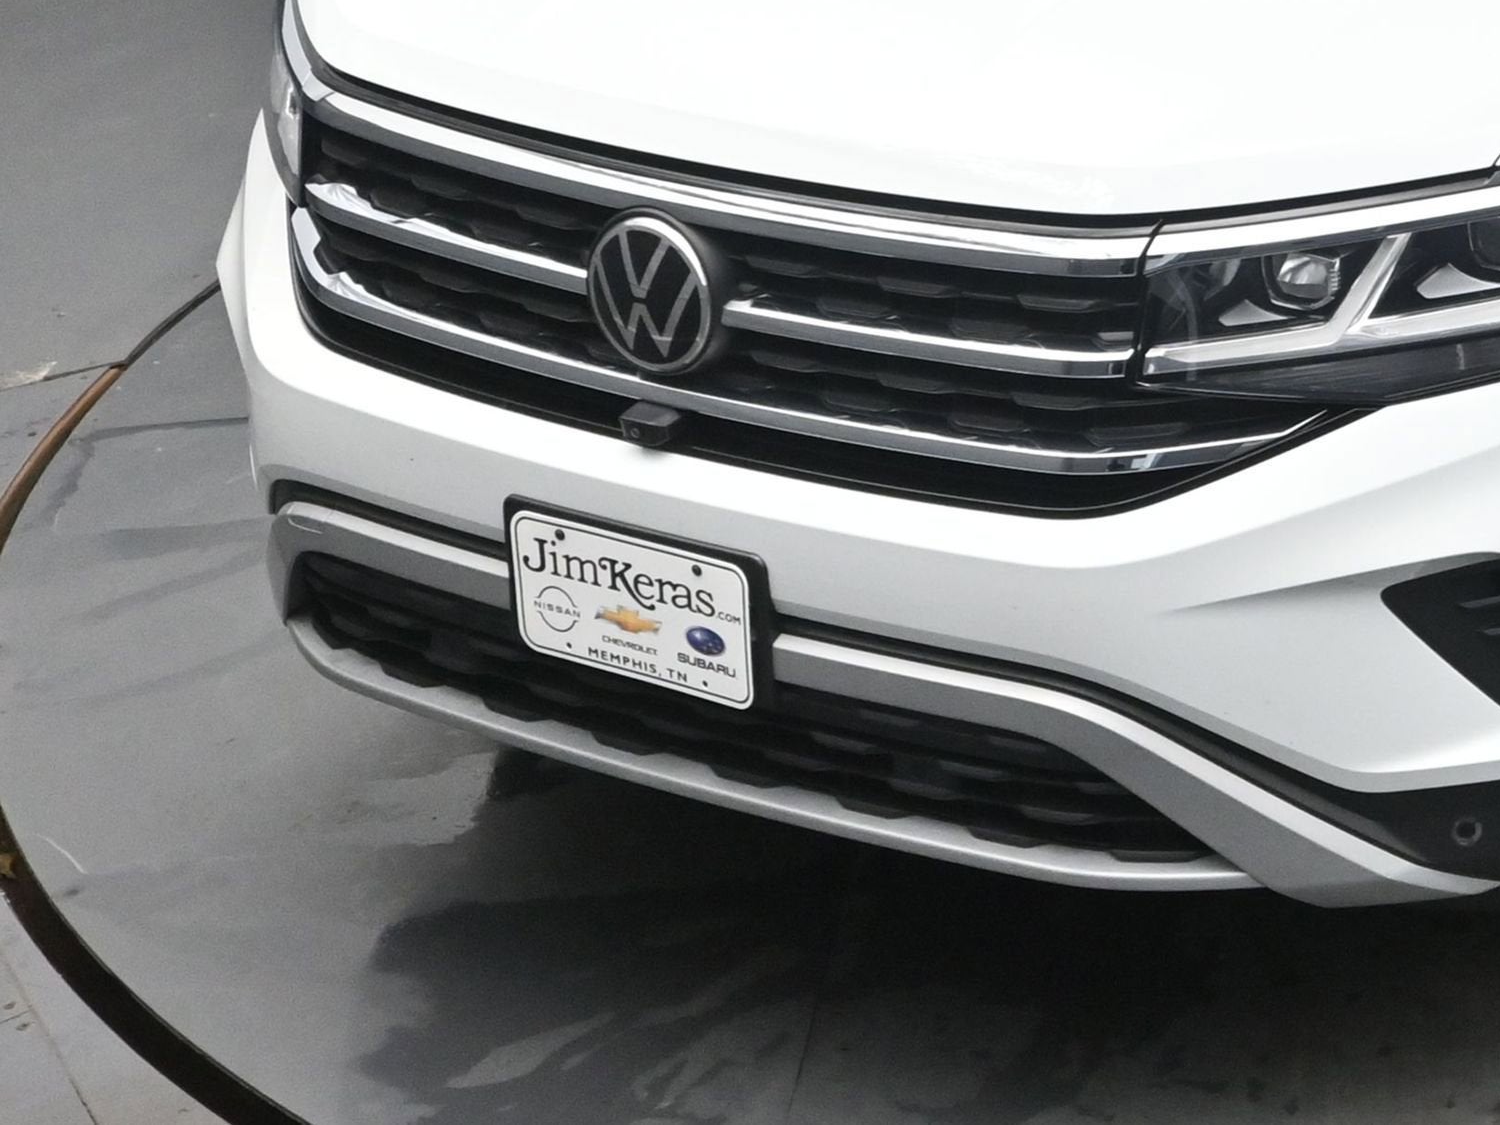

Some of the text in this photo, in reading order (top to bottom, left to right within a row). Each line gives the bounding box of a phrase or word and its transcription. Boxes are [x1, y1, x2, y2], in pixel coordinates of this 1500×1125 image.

[534, 600, 581, 619] NISSAN
[602, 635, 658, 656] CHEVROLET
[588, 647, 688, 683] MEMPHIS, TN
[677, 652, 737, 678] SUBARU
